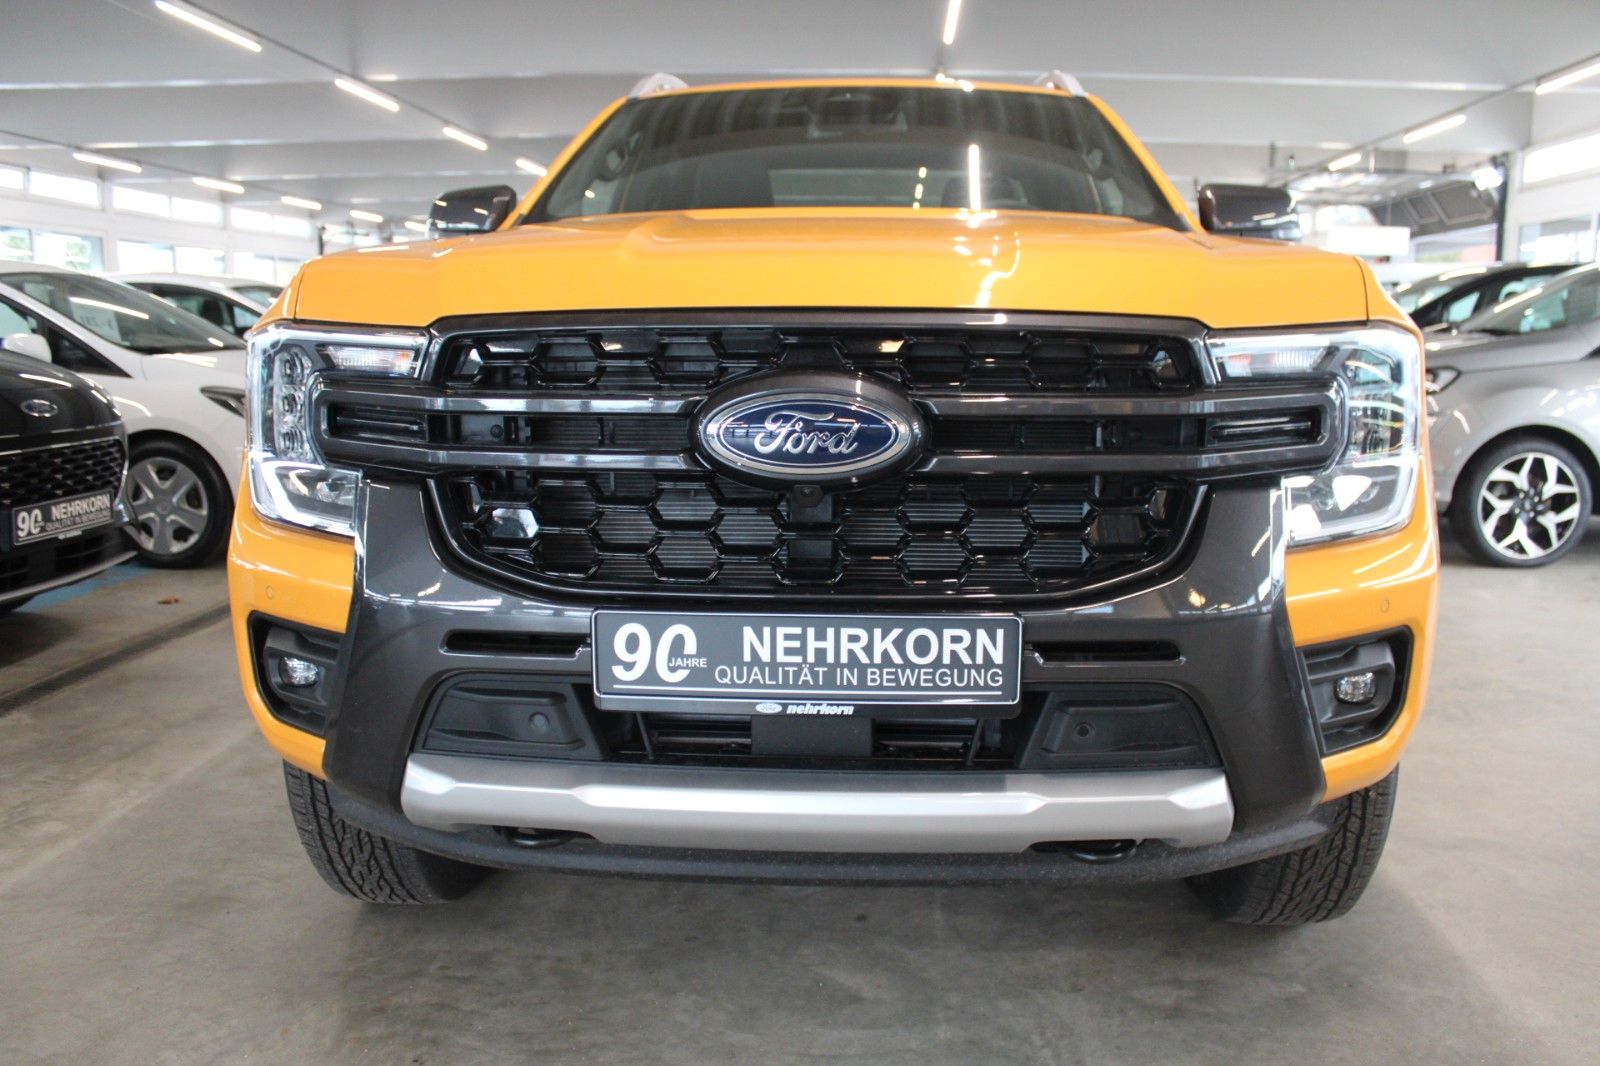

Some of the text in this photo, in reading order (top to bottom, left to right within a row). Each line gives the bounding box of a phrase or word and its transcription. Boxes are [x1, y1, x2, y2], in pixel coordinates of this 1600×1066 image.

[754, 410, 861, 455] Ford
[17, 509, 42, 538] 90
[51, 494, 111, 521] NEHRKORN
[611, 622, 1004, 683] 90 NEHRKORN
[668, 657, 708, 668] JAHRE
[714, 664, 1003, 687] QUALITÄT IN BEWEGUNG
[786, 703, 855, 715] nehrkorn
